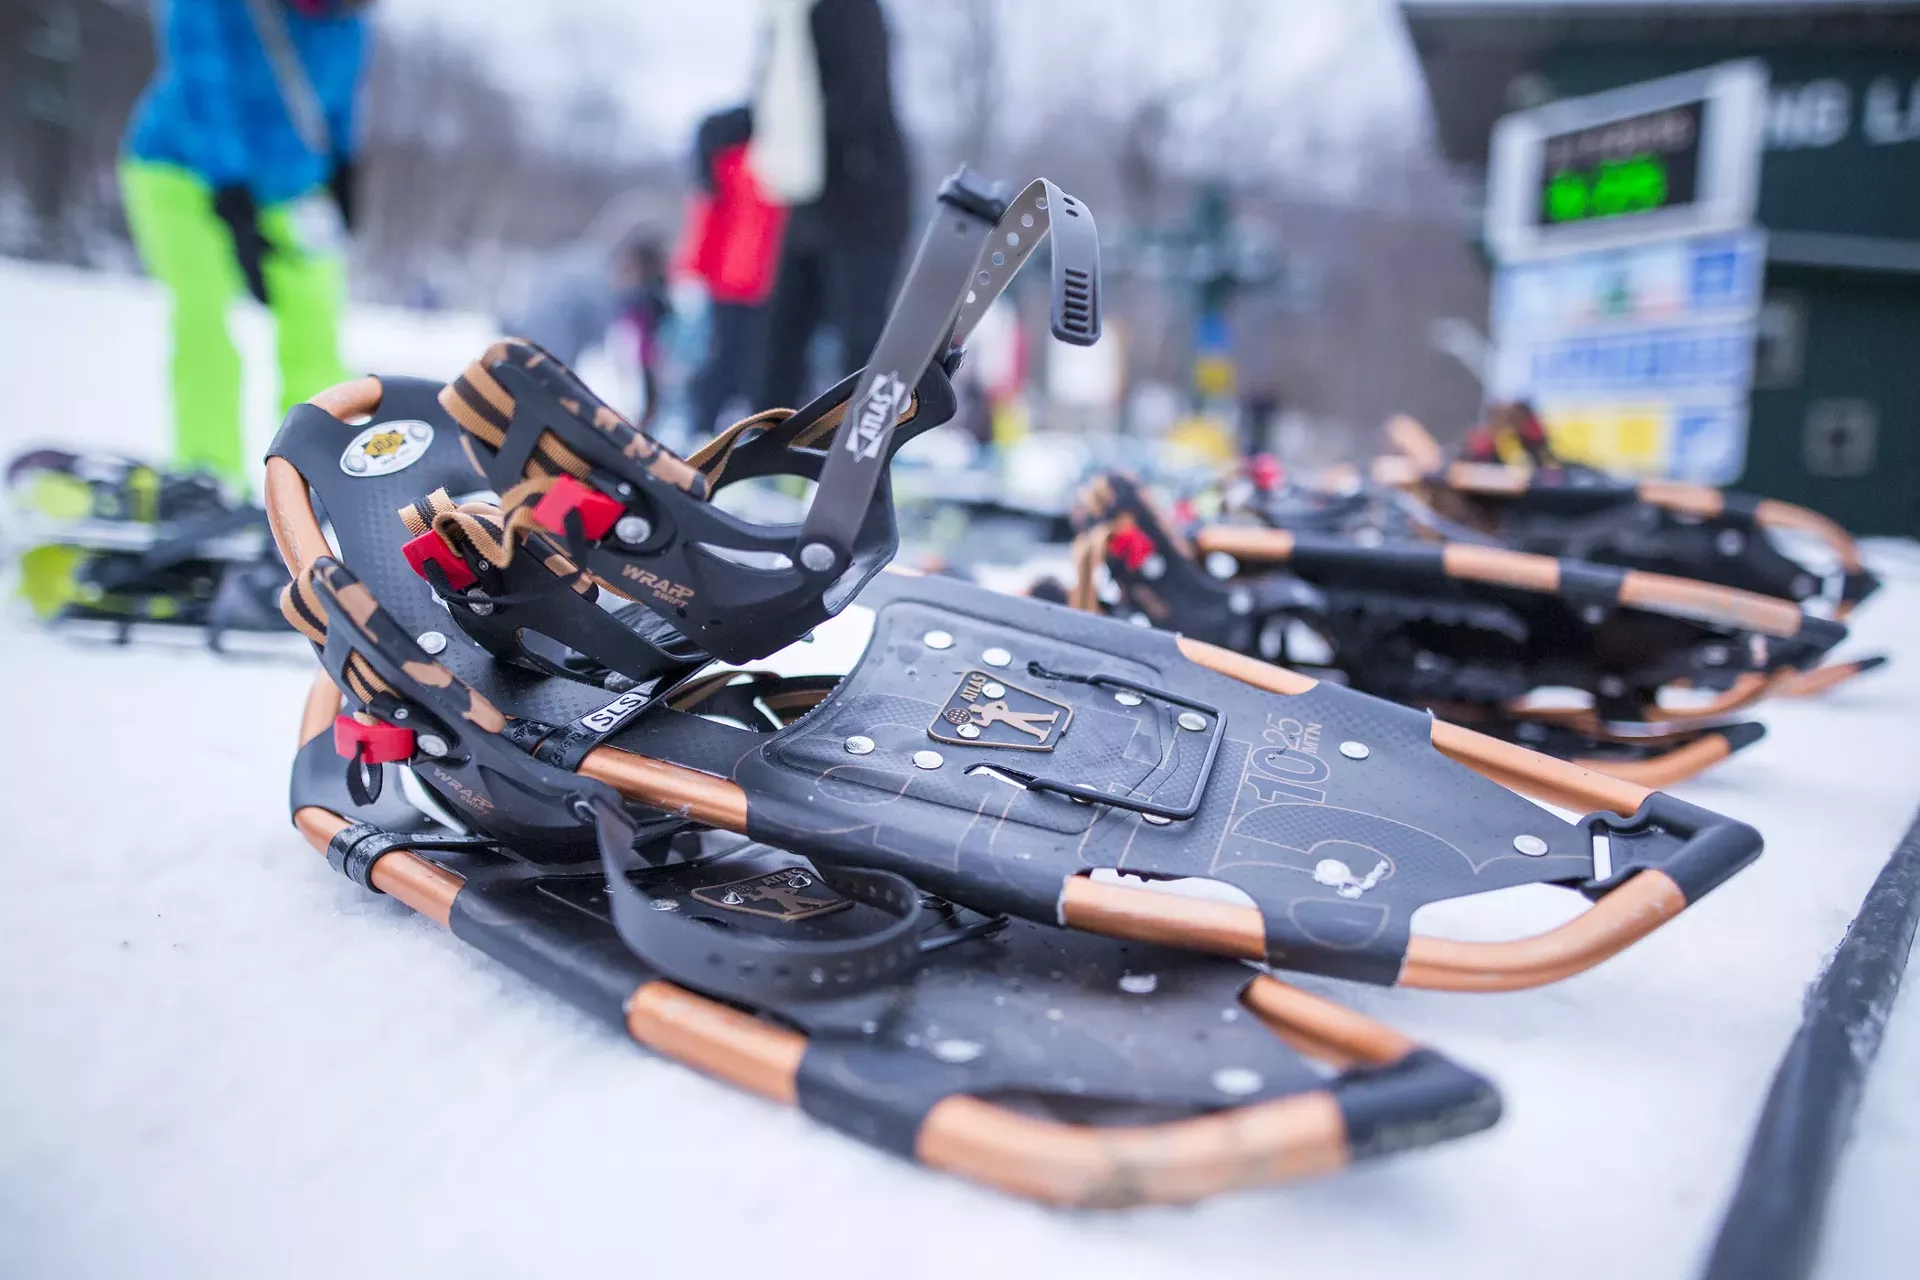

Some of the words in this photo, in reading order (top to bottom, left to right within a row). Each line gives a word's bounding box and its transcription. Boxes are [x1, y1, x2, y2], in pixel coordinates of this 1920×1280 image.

[960, 674, 986, 702] ATLAS
[590, 696, 642, 727] SLS
[1301, 722, 1322, 754] MTN
